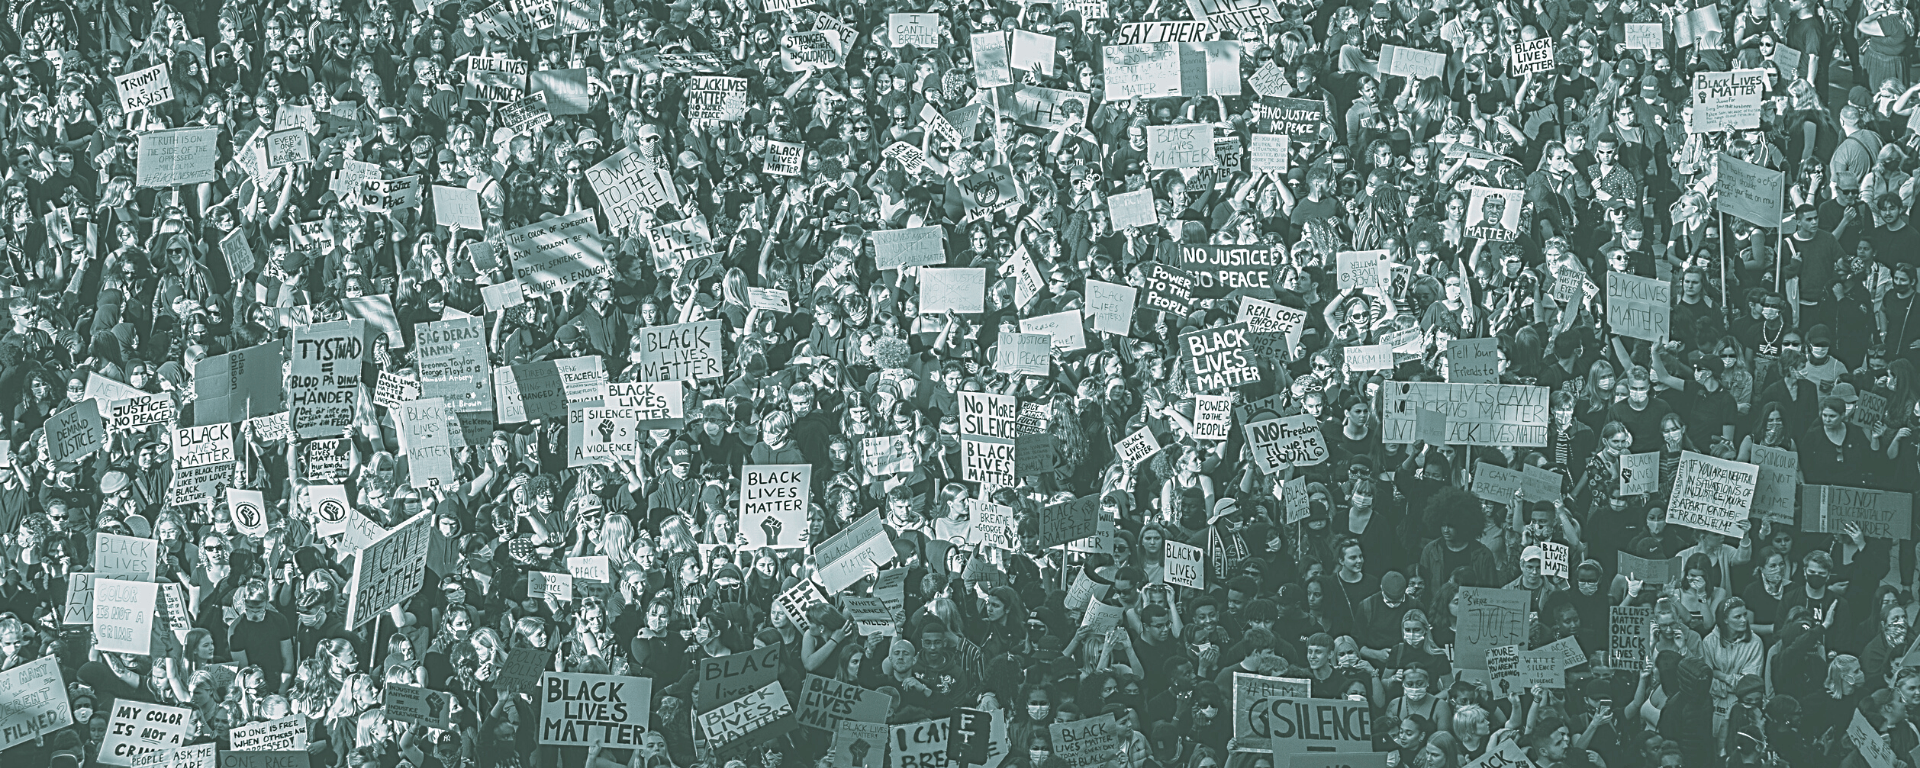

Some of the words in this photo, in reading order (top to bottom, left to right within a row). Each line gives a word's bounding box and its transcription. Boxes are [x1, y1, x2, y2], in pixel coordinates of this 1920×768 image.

[786, 32, 828, 48] STRONGER
[1119, 23, 1152, 45] SAY
[1160, 22, 1207, 42] THEIR
[800, 42, 831, 51] TOGETHER
[1514, 39, 1550, 54] BLACK
[796, 49, 836, 65] SOLIDARITY
[1517, 50, 1548, 63] LIVES
[472, 58, 496, 71] BLUE
[500, 60, 527, 75] LIVES
[1513, 59, 1553, 75] MATTER
[121, 69, 160, 91] TRUMP
[691, 78, 720, 91] BLACK
[722, 79, 746, 91] LIVES
[1698, 74, 1729, 90] BLACK
[1731, 73, 1762, 86] LIVES
[476, 84, 523, 102] MURDER
[691, 91, 726, 105] MATTER
[1712, 85, 1756, 98] MATTER
[1156, 128, 1195, 143] BLACK
[1269, 122, 1282, 133] NO
[1285, 122, 1313, 134] PEACE
[770, 144, 802, 156] BLACK
[1153, 147, 1213, 166] MATTER
[772, 154, 798, 164] LIVES
[364, 181, 380, 191] NO
[619, 169, 649, 195] THE
[362, 194, 378, 206] NO
[300, 222, 324, 236] BLACK
[507, 232, 525, 245] THE
[527, 228, 545, 239] COLOR
[650, 217, 703, 243] BLACK
[655, 232, 704, 253] LIVES
[513, 249, 531, 261] SKIN
[1184, 248, 1207, 265] NO
[1210, 246, 1270, 266] JUSTICE
[518, 263, 545, 278] DEATH
[548, 252, 582, 269] SENTENCE
[1152, 265, 1190, 289] POWER
[1219, 271, 1268, 289] PEACE
[1146, 277, 1163, 291] TO
[1169, 283, 1189, 300] THE
[1609, 275, 1637, 299] BLACK
[1639, 281, 1667, 303] LIVES
[1146, 291, 1186, 317] PEOPLE
[1246, 304, 1273, 318] REAL
[1276, 310, 1304, 324] COPS
[1611, 305, 1664, 334] MATTER
[1250, 317, 1293, 334] ENFORCE
[646, 326, 711, 352] BLACK
[1000, 334, 1013, 345] NO
[1017, 334, 1048, 345] JUSTICE
[1189, 328, 1250, 357] BLACK
[1450, 345, 1468, 359] Tell
[1192, 350, 1248, 373] LIVES
[1454, 362, 1482, 377] friends
[1483, 364, 1494, 376] to
[565, 371, 602, 382] PEACEFUL
[1197, 366, 1260, 391] MATTER
[293, 387, 353, 406] HÄNDER
[608, 383, 656, 397] BLACK
[113, 400, 168, 417] JUSTICE
[130, 396, 151, 407] NO
[619, 396, 667, 409] LIVES
[988, 396, 1015, 419] MORE
[1199, 399, 1230, 412] POWER
[132, 410, 169, 424] PEACE
[407, 407, 442, 421] BLACK
[588, 408, 633, 420] SILENCE
[1481, 401, 1543, 422] MATTER
[60, 412, 77, 428] WE
[967, 415, 1016, 440] SILENCE
[57, 419, 88, 442] DEMAND
[180, 424, 229, 447] BLACK
[1196, 422, 1227, 436] PEOPLE
[55, 428, 96, 461] JUSTICE
[587, 442, 633, 453] VIOLENCE
[1122, 432, 1145, 449] BLACK
[968, 442, 1016, 460] BLACK
[1124, 441, 1145, 457] LIVES
[1130, 444, 1153, 462] MATTER
[968, 456, 1011, 474] LIVES
[1627, 454, 1654, 468] BLACK
[177, 469, 193, 479] LOVE
[195, 467, 213, 477] BLACK
[748, 471, 802, 486] BLACK
[968, 468, 1014, 486] MATTER
[176, 477, 193, 486] LIKE
[175, 487, 198, 497] BLACK
[175, 493, 206, 505] CULTURE
[748, 487, 798, 500] LIVES
[1853, 492, 1883, 507] NOT
[745, 499, 803, 515] MATTER
[101, 536, 151, 557] BLACK
[823, 541, 851, 566] BLACK
[1166, 543, 1192, 561] BLACK
[1542, 543, 1567, 555] BLACK
[104, 556, 149, 571] LIVES
[1544, 551, 1566, 562] LIVES
[1170, 561, 1197, 580] LIVES
[533, 584, 561, 592] JUSTICE
[1171, 577, 1193, 586] MATTER
[1612, 607, 1628, 616] ALL
[1611, 616, 1644, 625] MATTER
[1611, 624, 1640, 635] ONCE
[1612, 636, 1646, 650] BLACK
[705, 652, 779, 681] BLACK
[1611, 659, 1644, 670] MATTER
[1528, 677, 1553, 685] VIOLENCE
[389, 685, 420, 695] INJUSTICE
[548, 677, 625, 703] BLACK
[809, 677, 864, 702] BLACK
[705, 687, 774, 727] BLACK
[805, 692, 855, 715] LIVES
[116, 706, 141, 720] MY
[146, 710, 183, 726] COLOR
[565, 701, 627, 723] LIVES
[706, 705, 771, 738] LIVES
[1271, 699, 1372, 742] SILENCE
[113, 722, 133, 736] IS
[141, 728, 166, 742] NOT
[234, 730, 247, 739] NO
[249, 727, 267, 737] ONE
[544, 717, 646, 746] MATTER
[1061, 722, 1108, 743] BLACK
[234, 738, 260, 748] WHEN
[1055, 741, 1080, 753] LIVES
[1084, 735, 1112, 746] MATTER
[173, 749, 194, 761] ASK
